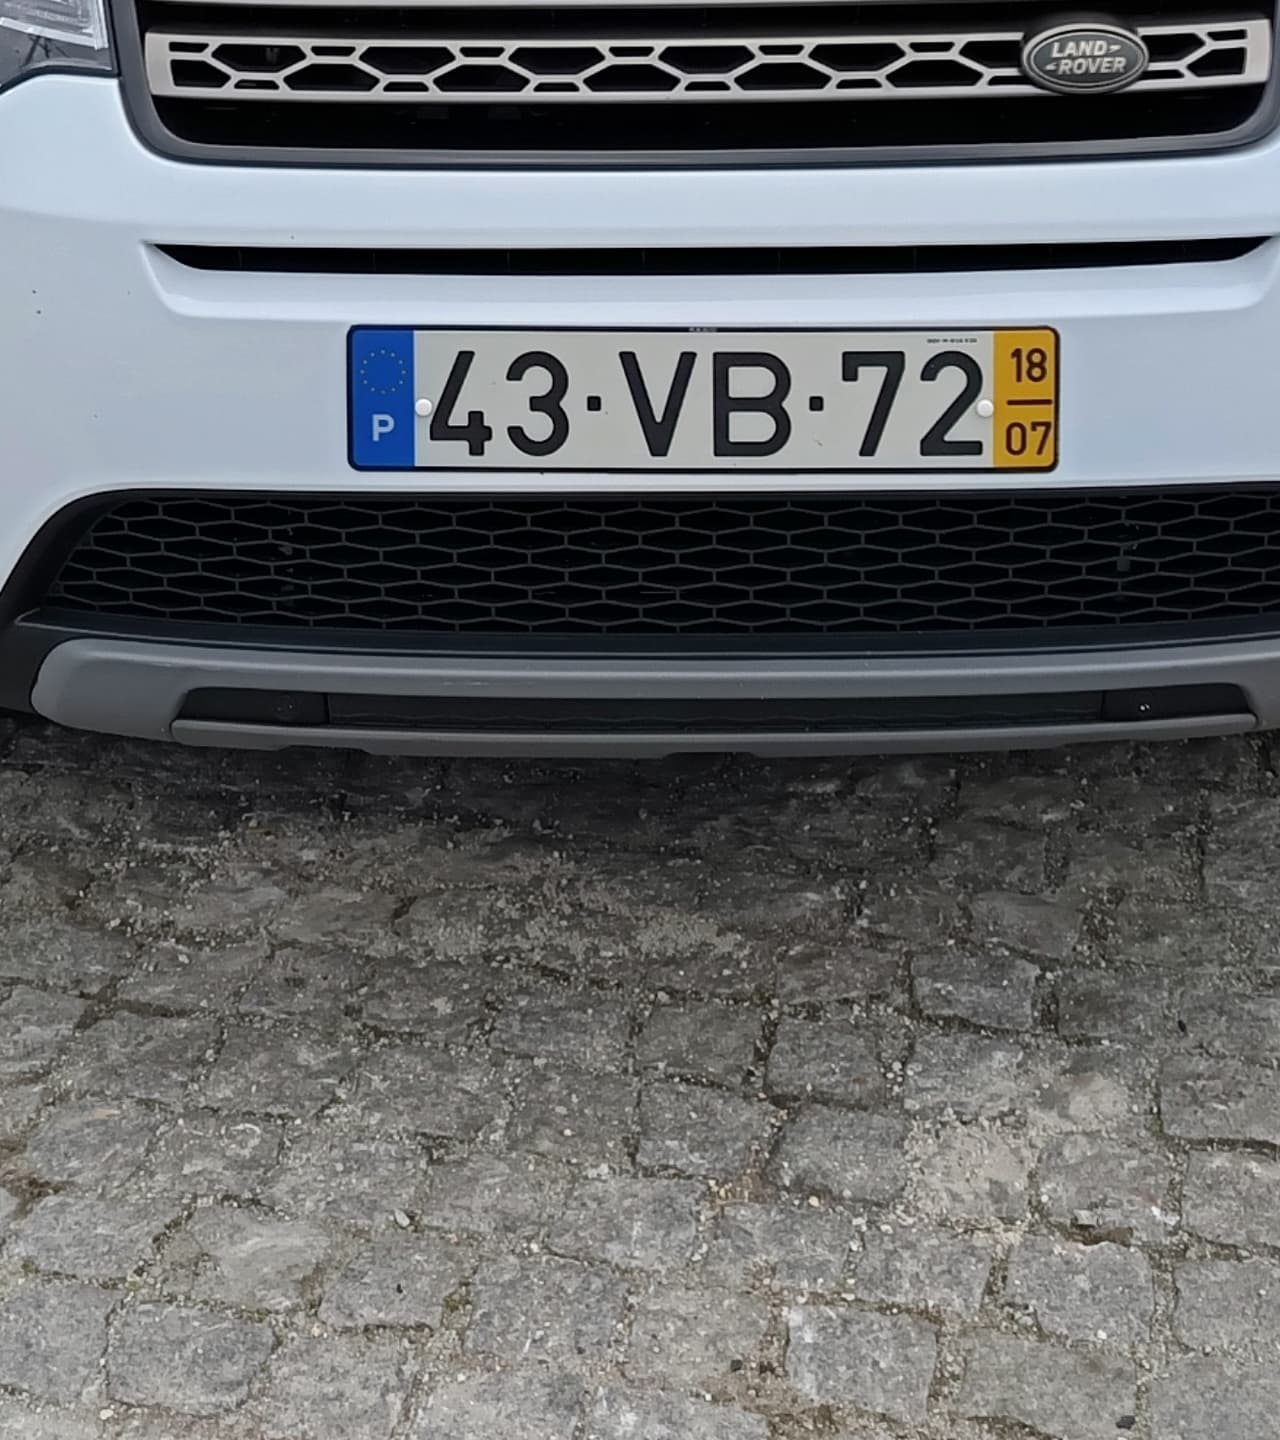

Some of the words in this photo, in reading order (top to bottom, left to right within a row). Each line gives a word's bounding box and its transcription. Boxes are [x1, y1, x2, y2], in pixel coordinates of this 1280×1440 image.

[1051, 40, 1108, 59] LAND
[1057, 56, 1127, 76] ROVER
[1010, 347, 1048, 383] 18
[372, 413, 396, 442] P
[1005, 421, 1052, 456] 07
